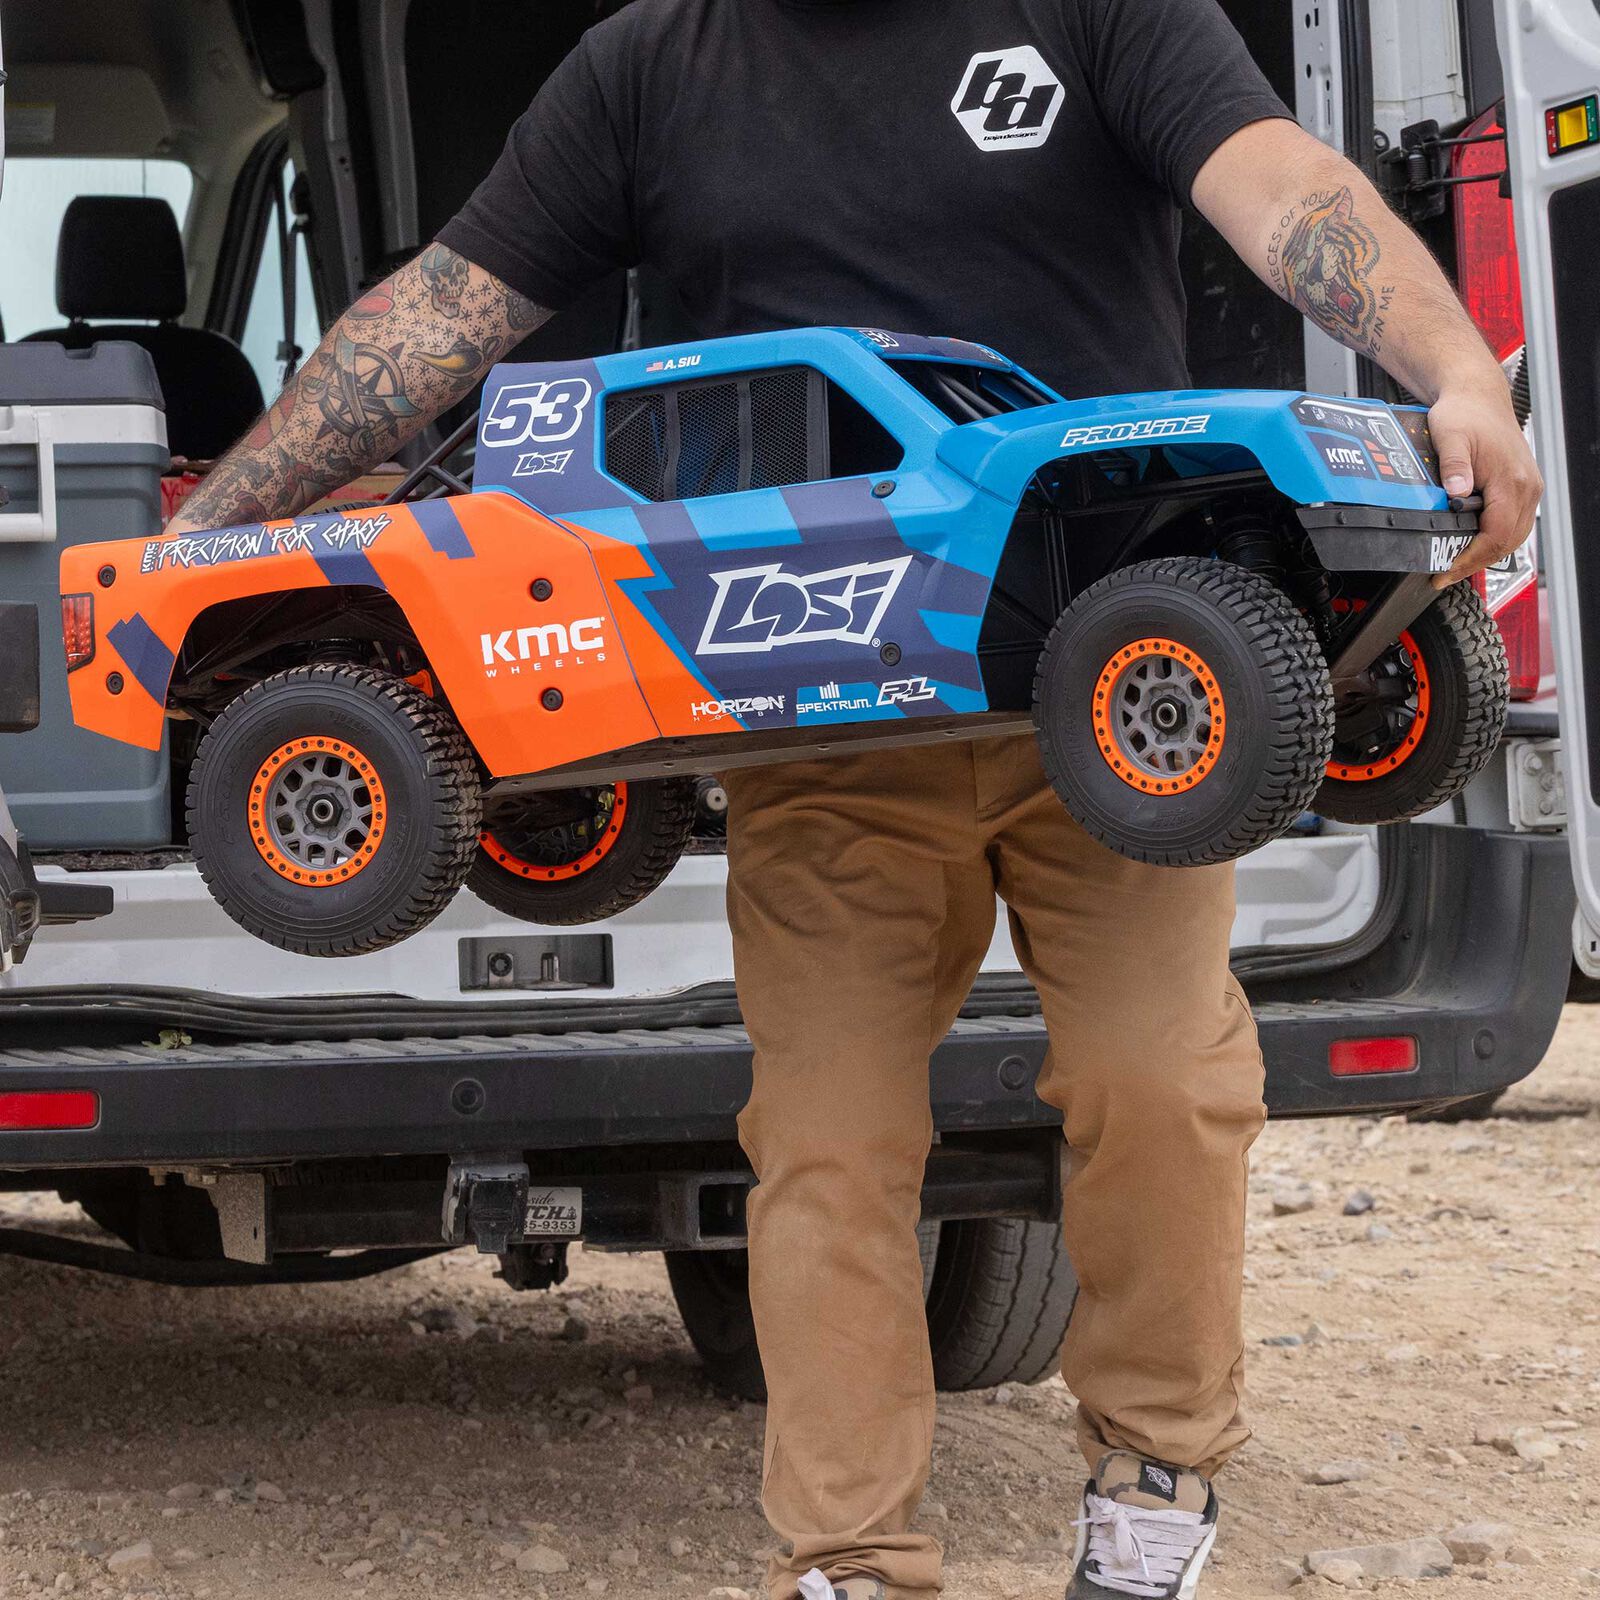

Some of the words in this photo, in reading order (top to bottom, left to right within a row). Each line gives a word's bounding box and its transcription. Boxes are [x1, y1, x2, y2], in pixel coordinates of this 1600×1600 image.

[1266, 231, 1287, 293] PIECES
[1280, 206, 1297, 229] OF
[1300, 190, 1330, 210] YOU
[1373, 316, 1385, 338] IN
[1379, 286, 1395, 310] ME
[481, 377, 592, 448] 53
[1060, 414, 1211, 447] PRO-LINE
[512, 449, 575, 477] LOSI
[1325, 447, 1365, 465] KMC
[157, 527, 264, 569] PRECISION
[271, 522, 317, 552] FOR
[321, 514, 393, 550] CHAOS
[695, 554, 914, 655] LOSI
[480, 616, 605, 666] KMC
[486, 652, 606, 678] WHEELS
[690, 695, 784, 716] HORIZON
[693, 708, 785, 722] HOBBY
[531, 1190, 555, 1205] side
